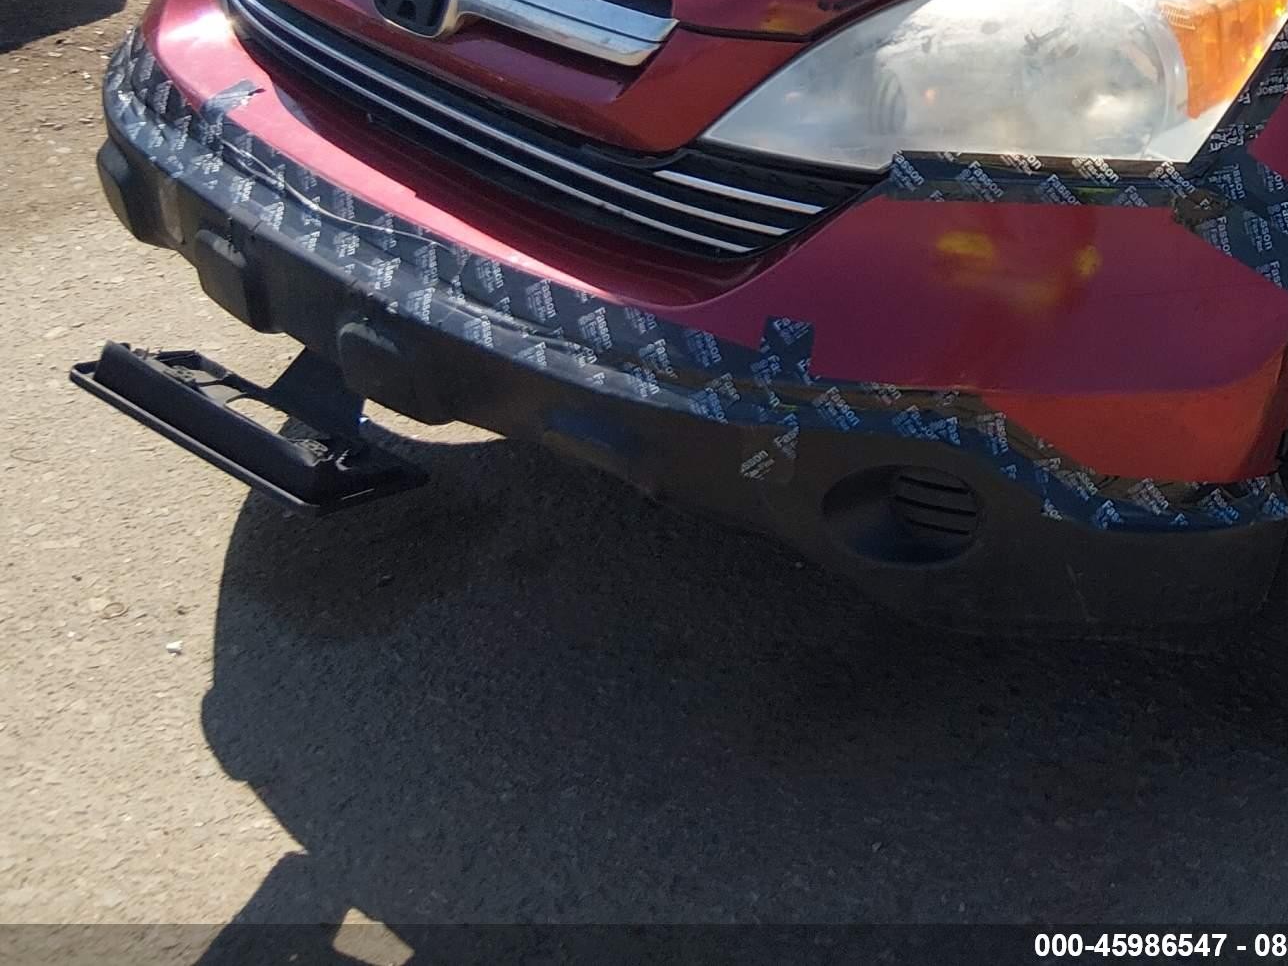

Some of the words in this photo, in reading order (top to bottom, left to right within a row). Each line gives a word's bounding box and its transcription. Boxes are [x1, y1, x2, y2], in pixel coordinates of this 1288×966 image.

[968, 160, 1005, 197] Fasson
[596, 306, 613, 350] Fasson
[826, 385, 861, 427] Fasson
